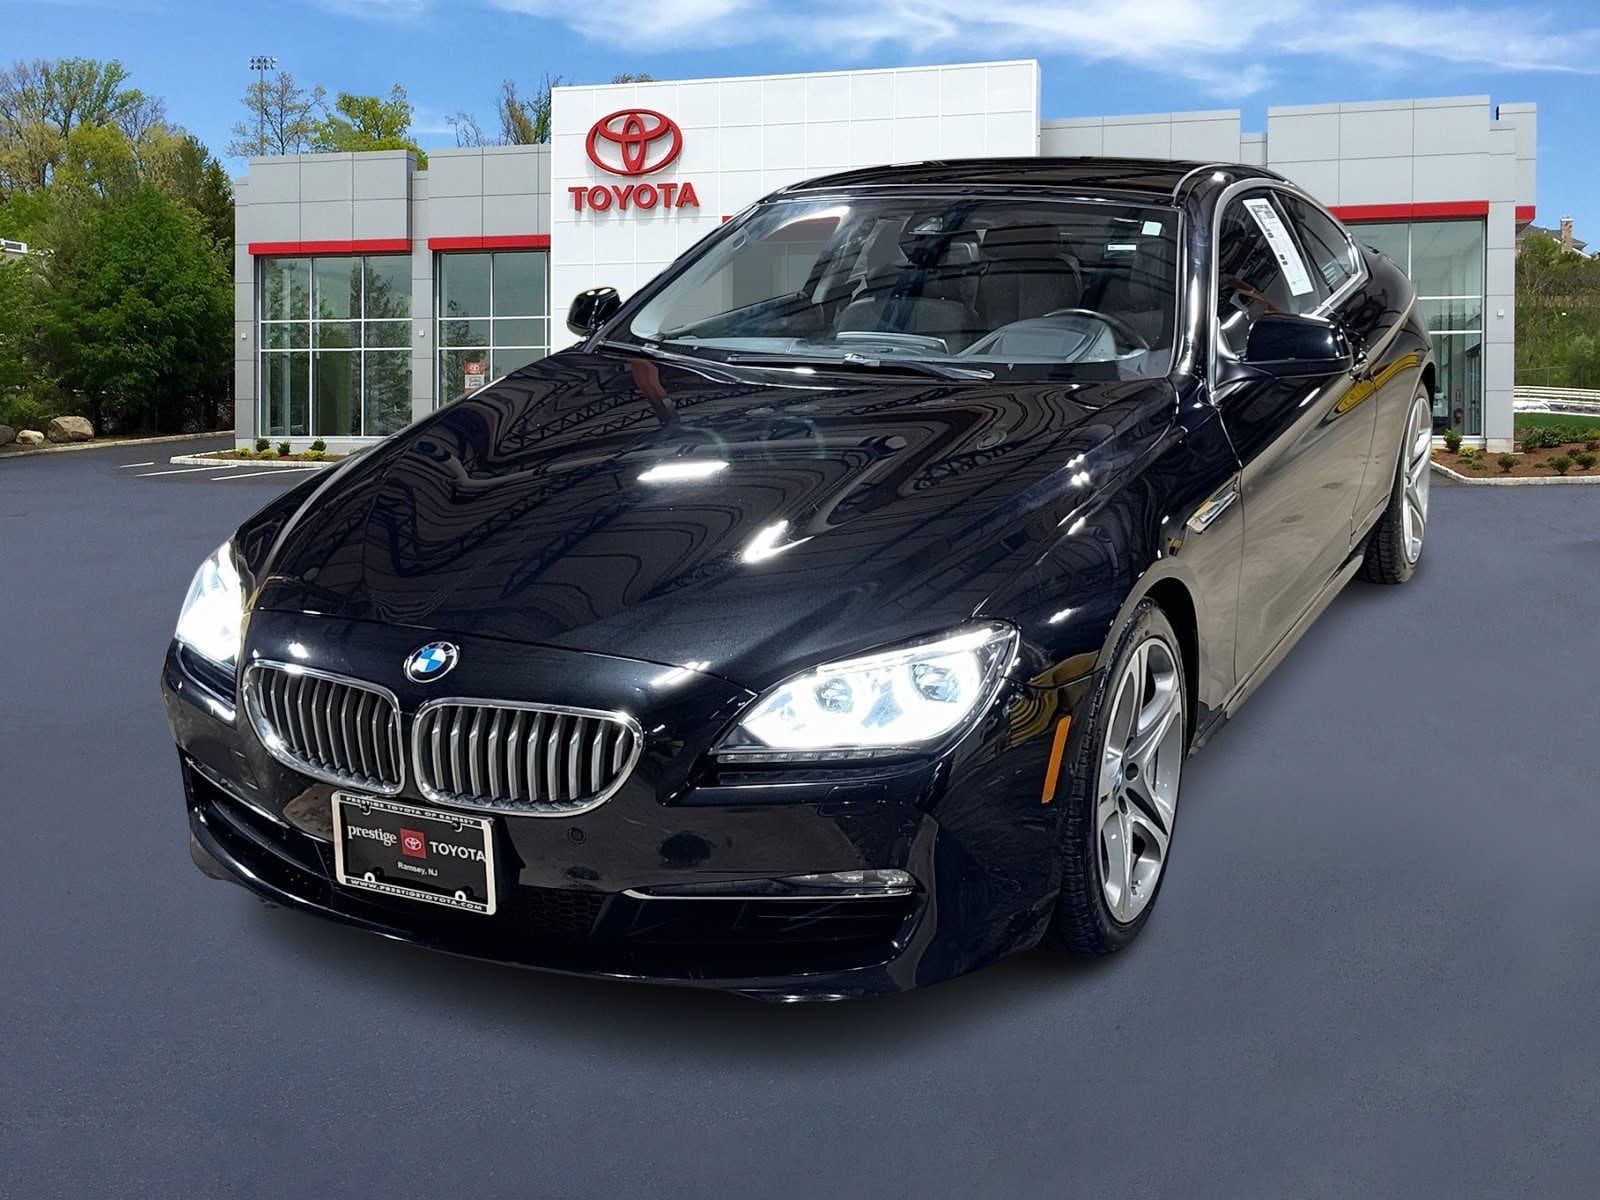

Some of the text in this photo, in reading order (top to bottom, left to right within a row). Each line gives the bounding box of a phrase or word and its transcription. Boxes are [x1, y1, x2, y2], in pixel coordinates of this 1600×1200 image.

[568, 182, 700, 212] TOYOTA
[387, 804, 421, 815] TOYOTA
[439, 814, 474, 825] RAMSEY
[347, 825, 486, 862] prestige TOYOTA
[397, 861, 438, 877] Ramsey, NJ
